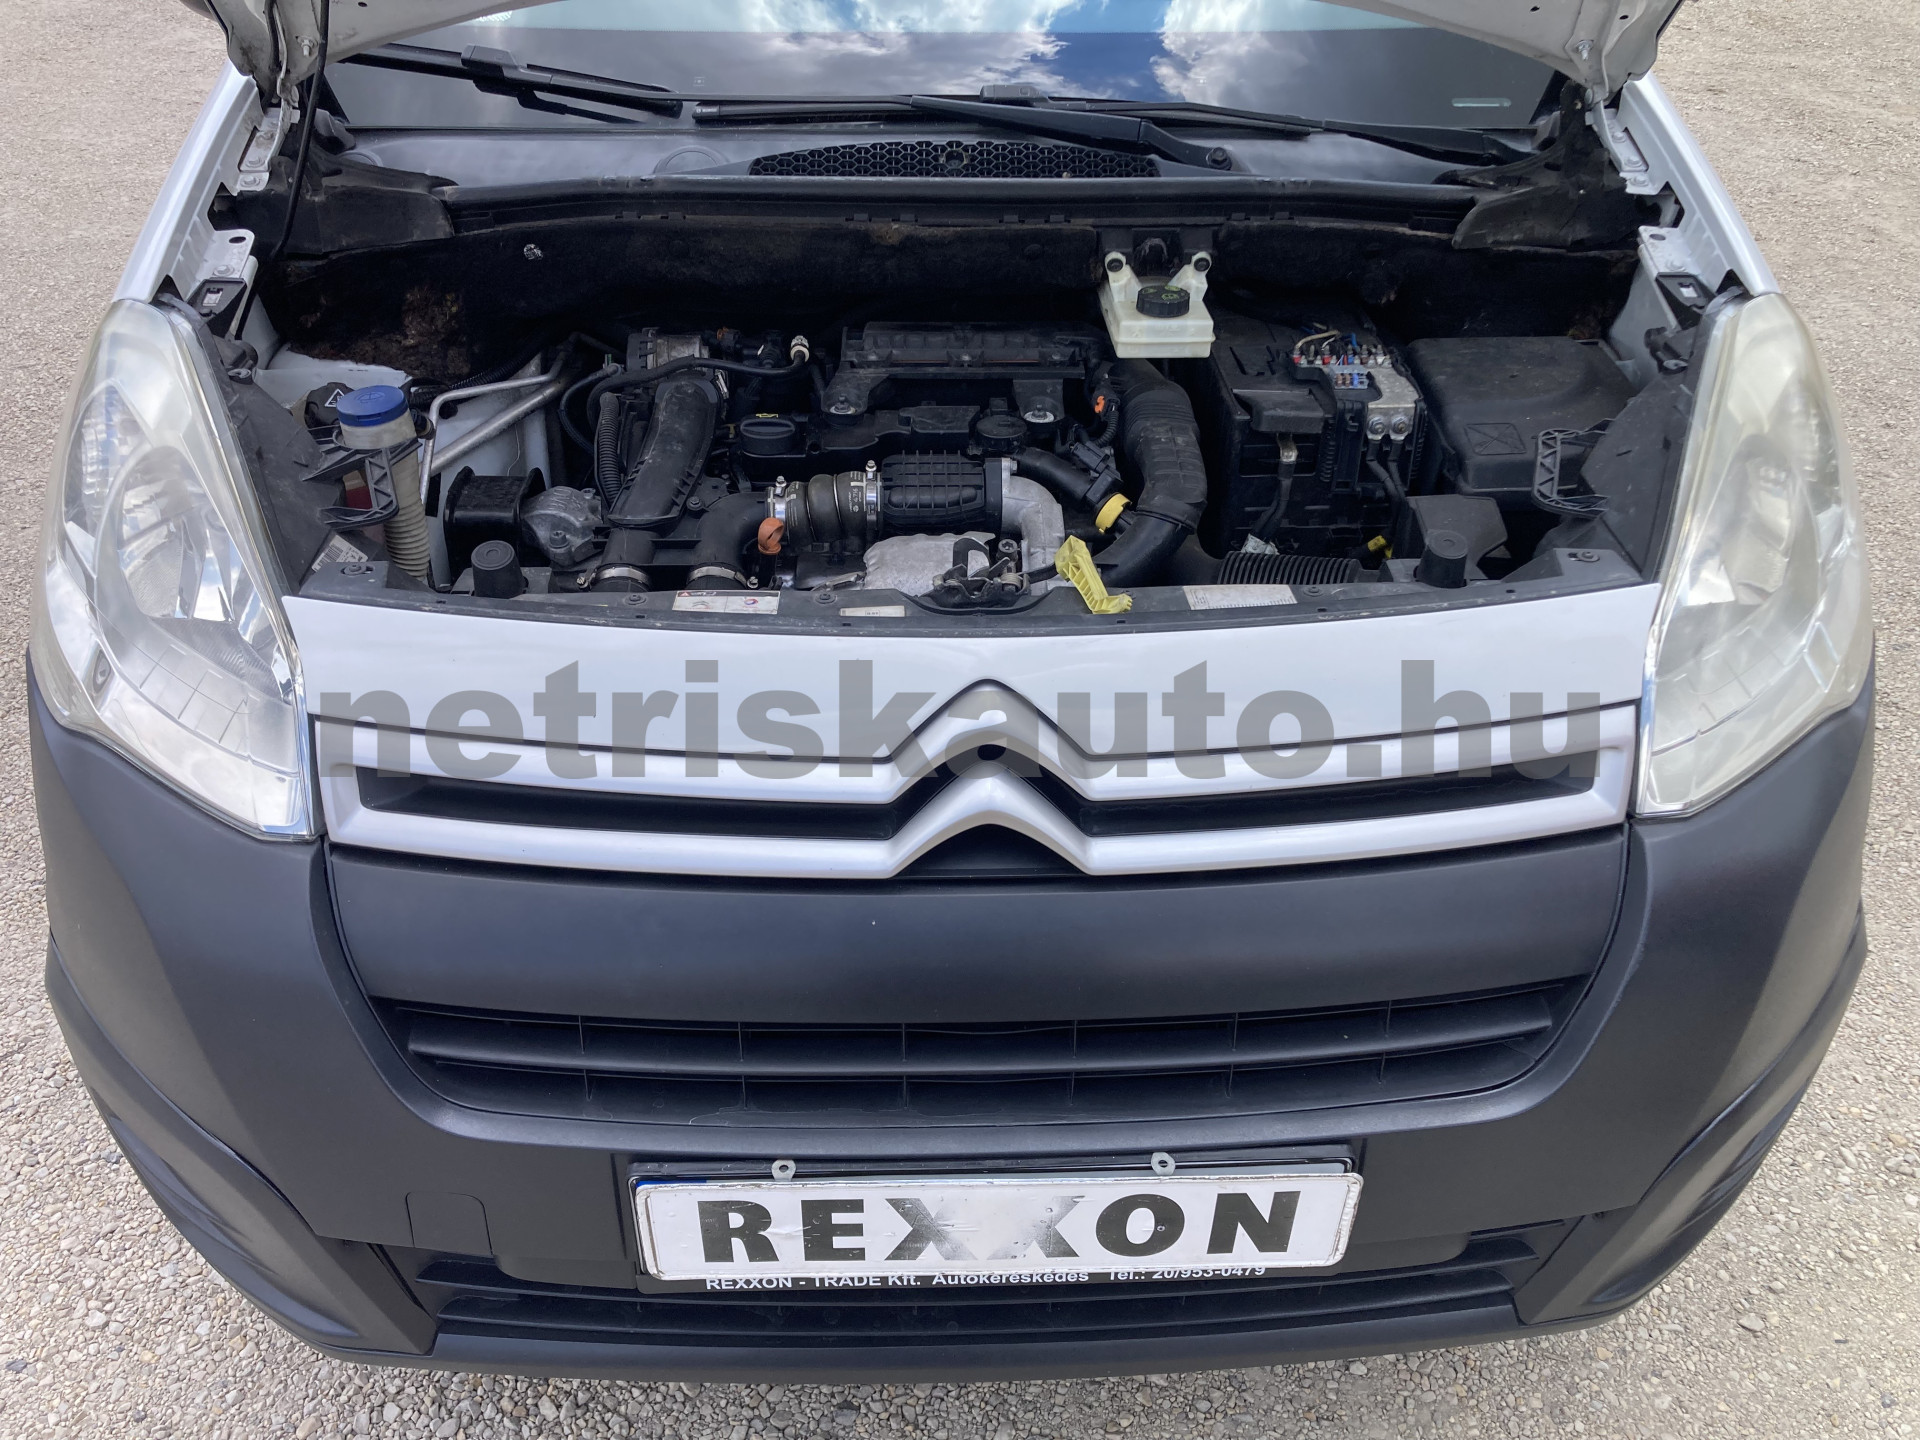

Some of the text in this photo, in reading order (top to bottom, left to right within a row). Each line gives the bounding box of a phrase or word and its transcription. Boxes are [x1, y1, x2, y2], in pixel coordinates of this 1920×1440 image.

[697, 1191, 1302, 1263] REXXON
[705, 1276, 792, 1290] REXXON
[811, 1274, 882, 1288] TRADE
[888, 1274, 921, 1286] Kft.
